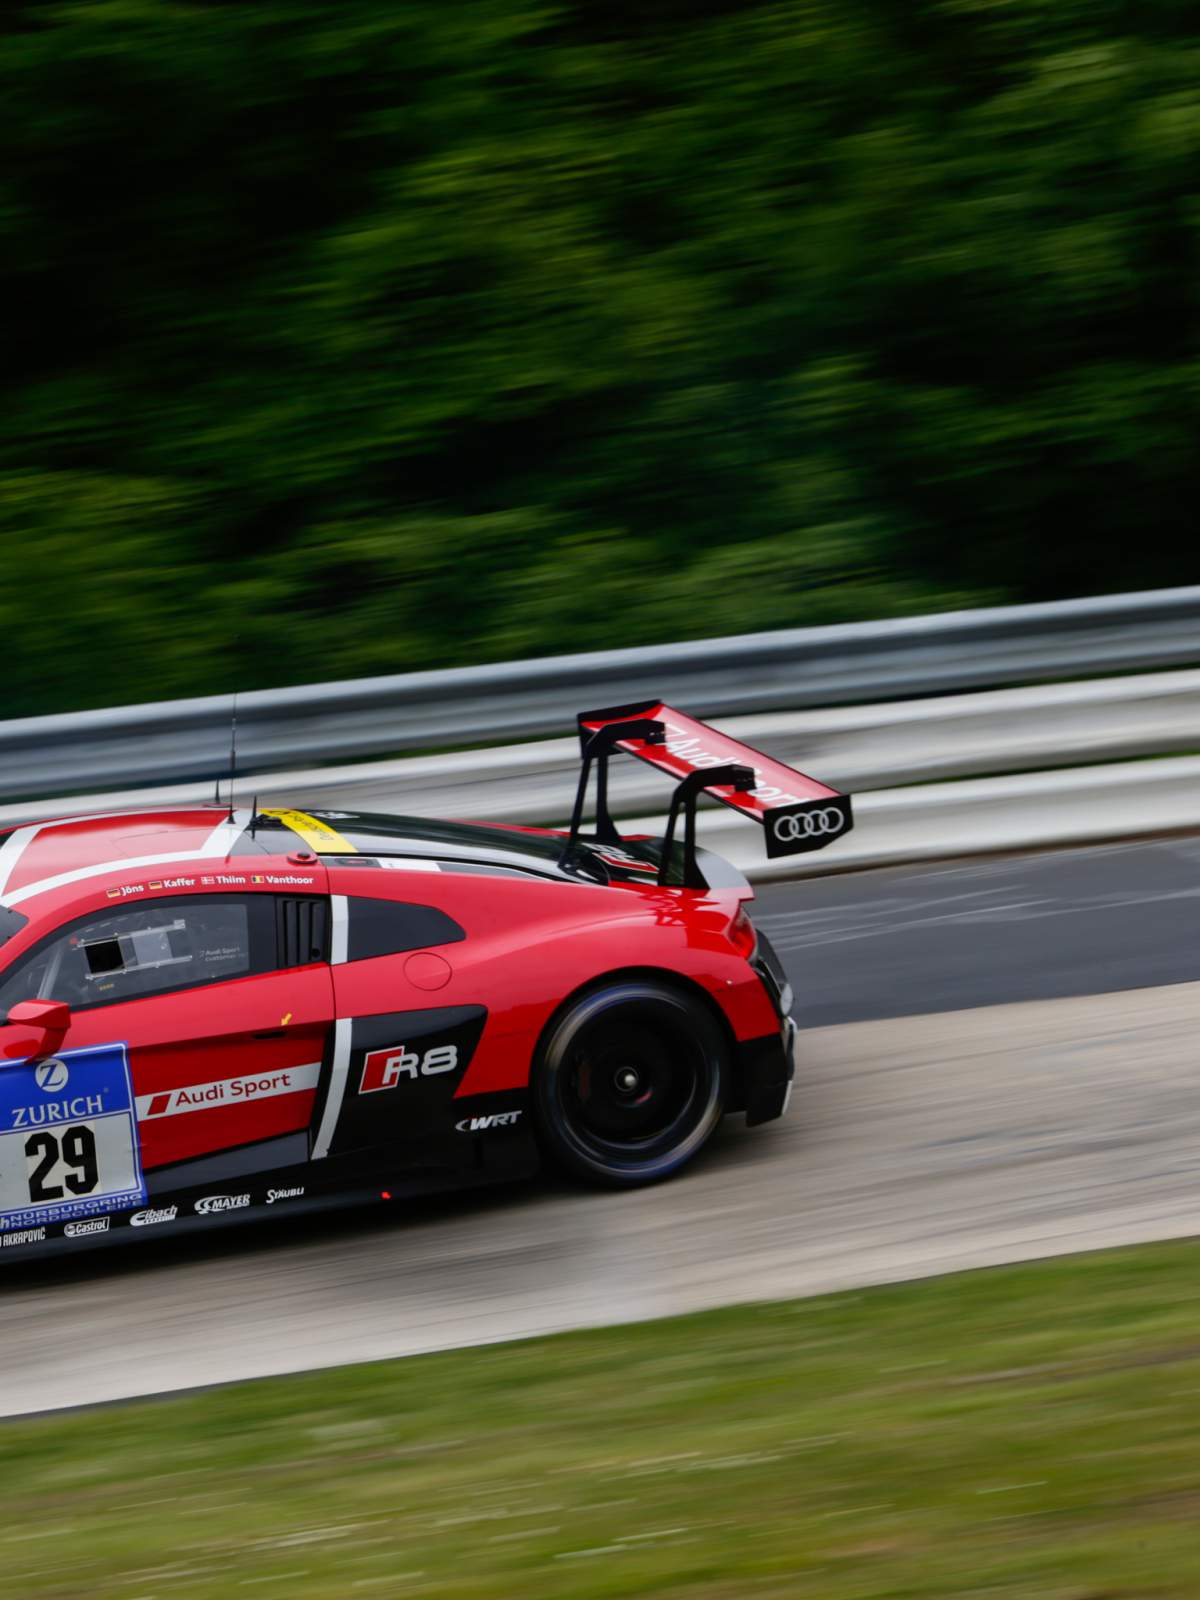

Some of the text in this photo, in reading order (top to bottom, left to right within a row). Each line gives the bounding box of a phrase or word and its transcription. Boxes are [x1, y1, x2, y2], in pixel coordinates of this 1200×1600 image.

[121, 884, 144, 896] Jöns
[163, 878, 195, 888] Kaffer
[266, 875, 314, 884] Vanthoor
[381, 1044, 458, 1085] R8
[175, 1073, 292, 1107] Audi Sport
[11, 1094, 104, 1128] ZURICH
[470, 1110, 523, 1130] WRT
[24, 1125, 99, 1203] 29
[10, 1201, 144, 1230] NORDSCHLEIFE
[75, 1217, 106, 1234] Castrol
[130, 1204, 178, 1226] Eibach
